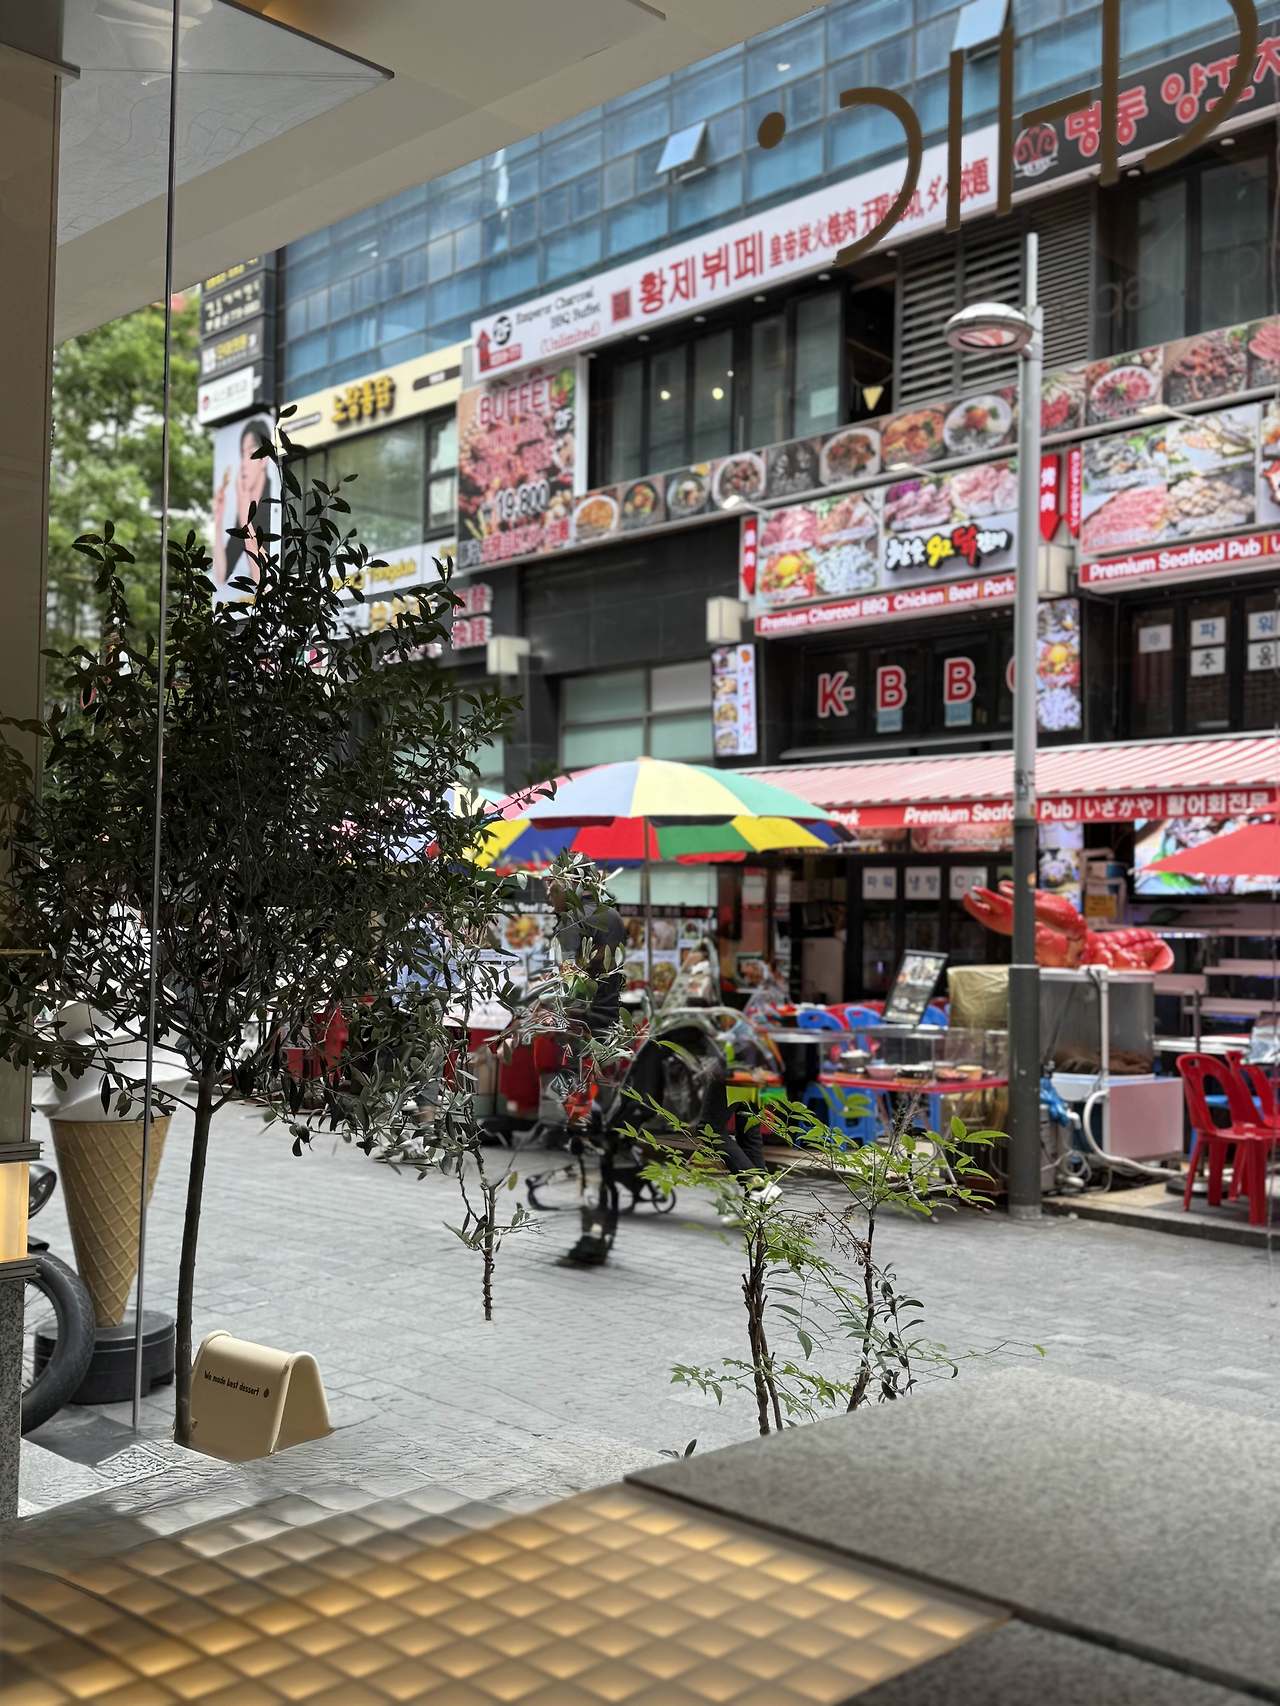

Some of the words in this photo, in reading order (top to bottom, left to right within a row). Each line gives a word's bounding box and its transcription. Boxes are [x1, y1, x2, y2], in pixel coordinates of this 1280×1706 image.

[640, 231, 764, 315] 황제뷔페
[479, 375, 556, 423] BUFFET
[1090, 557, 1156, 581] Premium
[1159, 543, 1225, 569] Seafood
[1228, 537, 1261, 560] Pub
[761, 610, 808, 631] Premium
[809, 603, 861, 623] Charcoal
[862, 597, 889, 615] BBQ
[893, 590, 944, 611] Chicken
[949, 581, 979, 602] Beef
[983, 575, 1014, 597] Pork
[903, 806, 970, 824] Premium
[1039, 800, 1074, 819] Pub
[1084, 796, 1154, 816] いざかや
[204, 1369, 212, 1379] We
[212, 1375, 226, 1386] made
[226, 1377, 239, 1390] best
[239, 1380, 260, 1395] dessert
